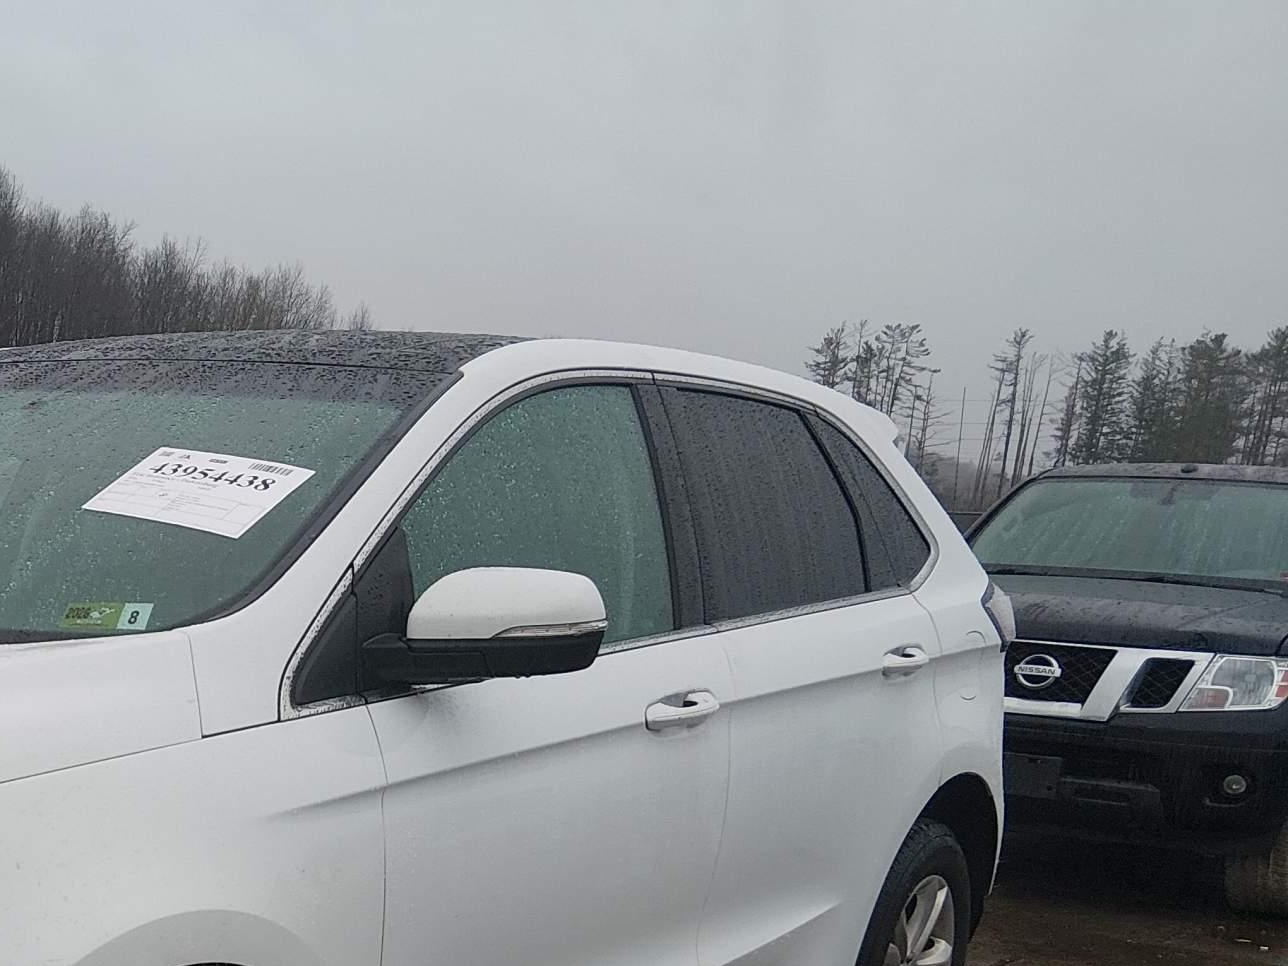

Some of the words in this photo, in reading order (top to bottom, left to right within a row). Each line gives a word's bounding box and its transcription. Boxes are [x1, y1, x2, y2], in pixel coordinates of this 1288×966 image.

[149, 461, 277, 492] 43954438
[127, 610, 140, 625] 8
[1017, 665, 1057, 675] NISSAN
